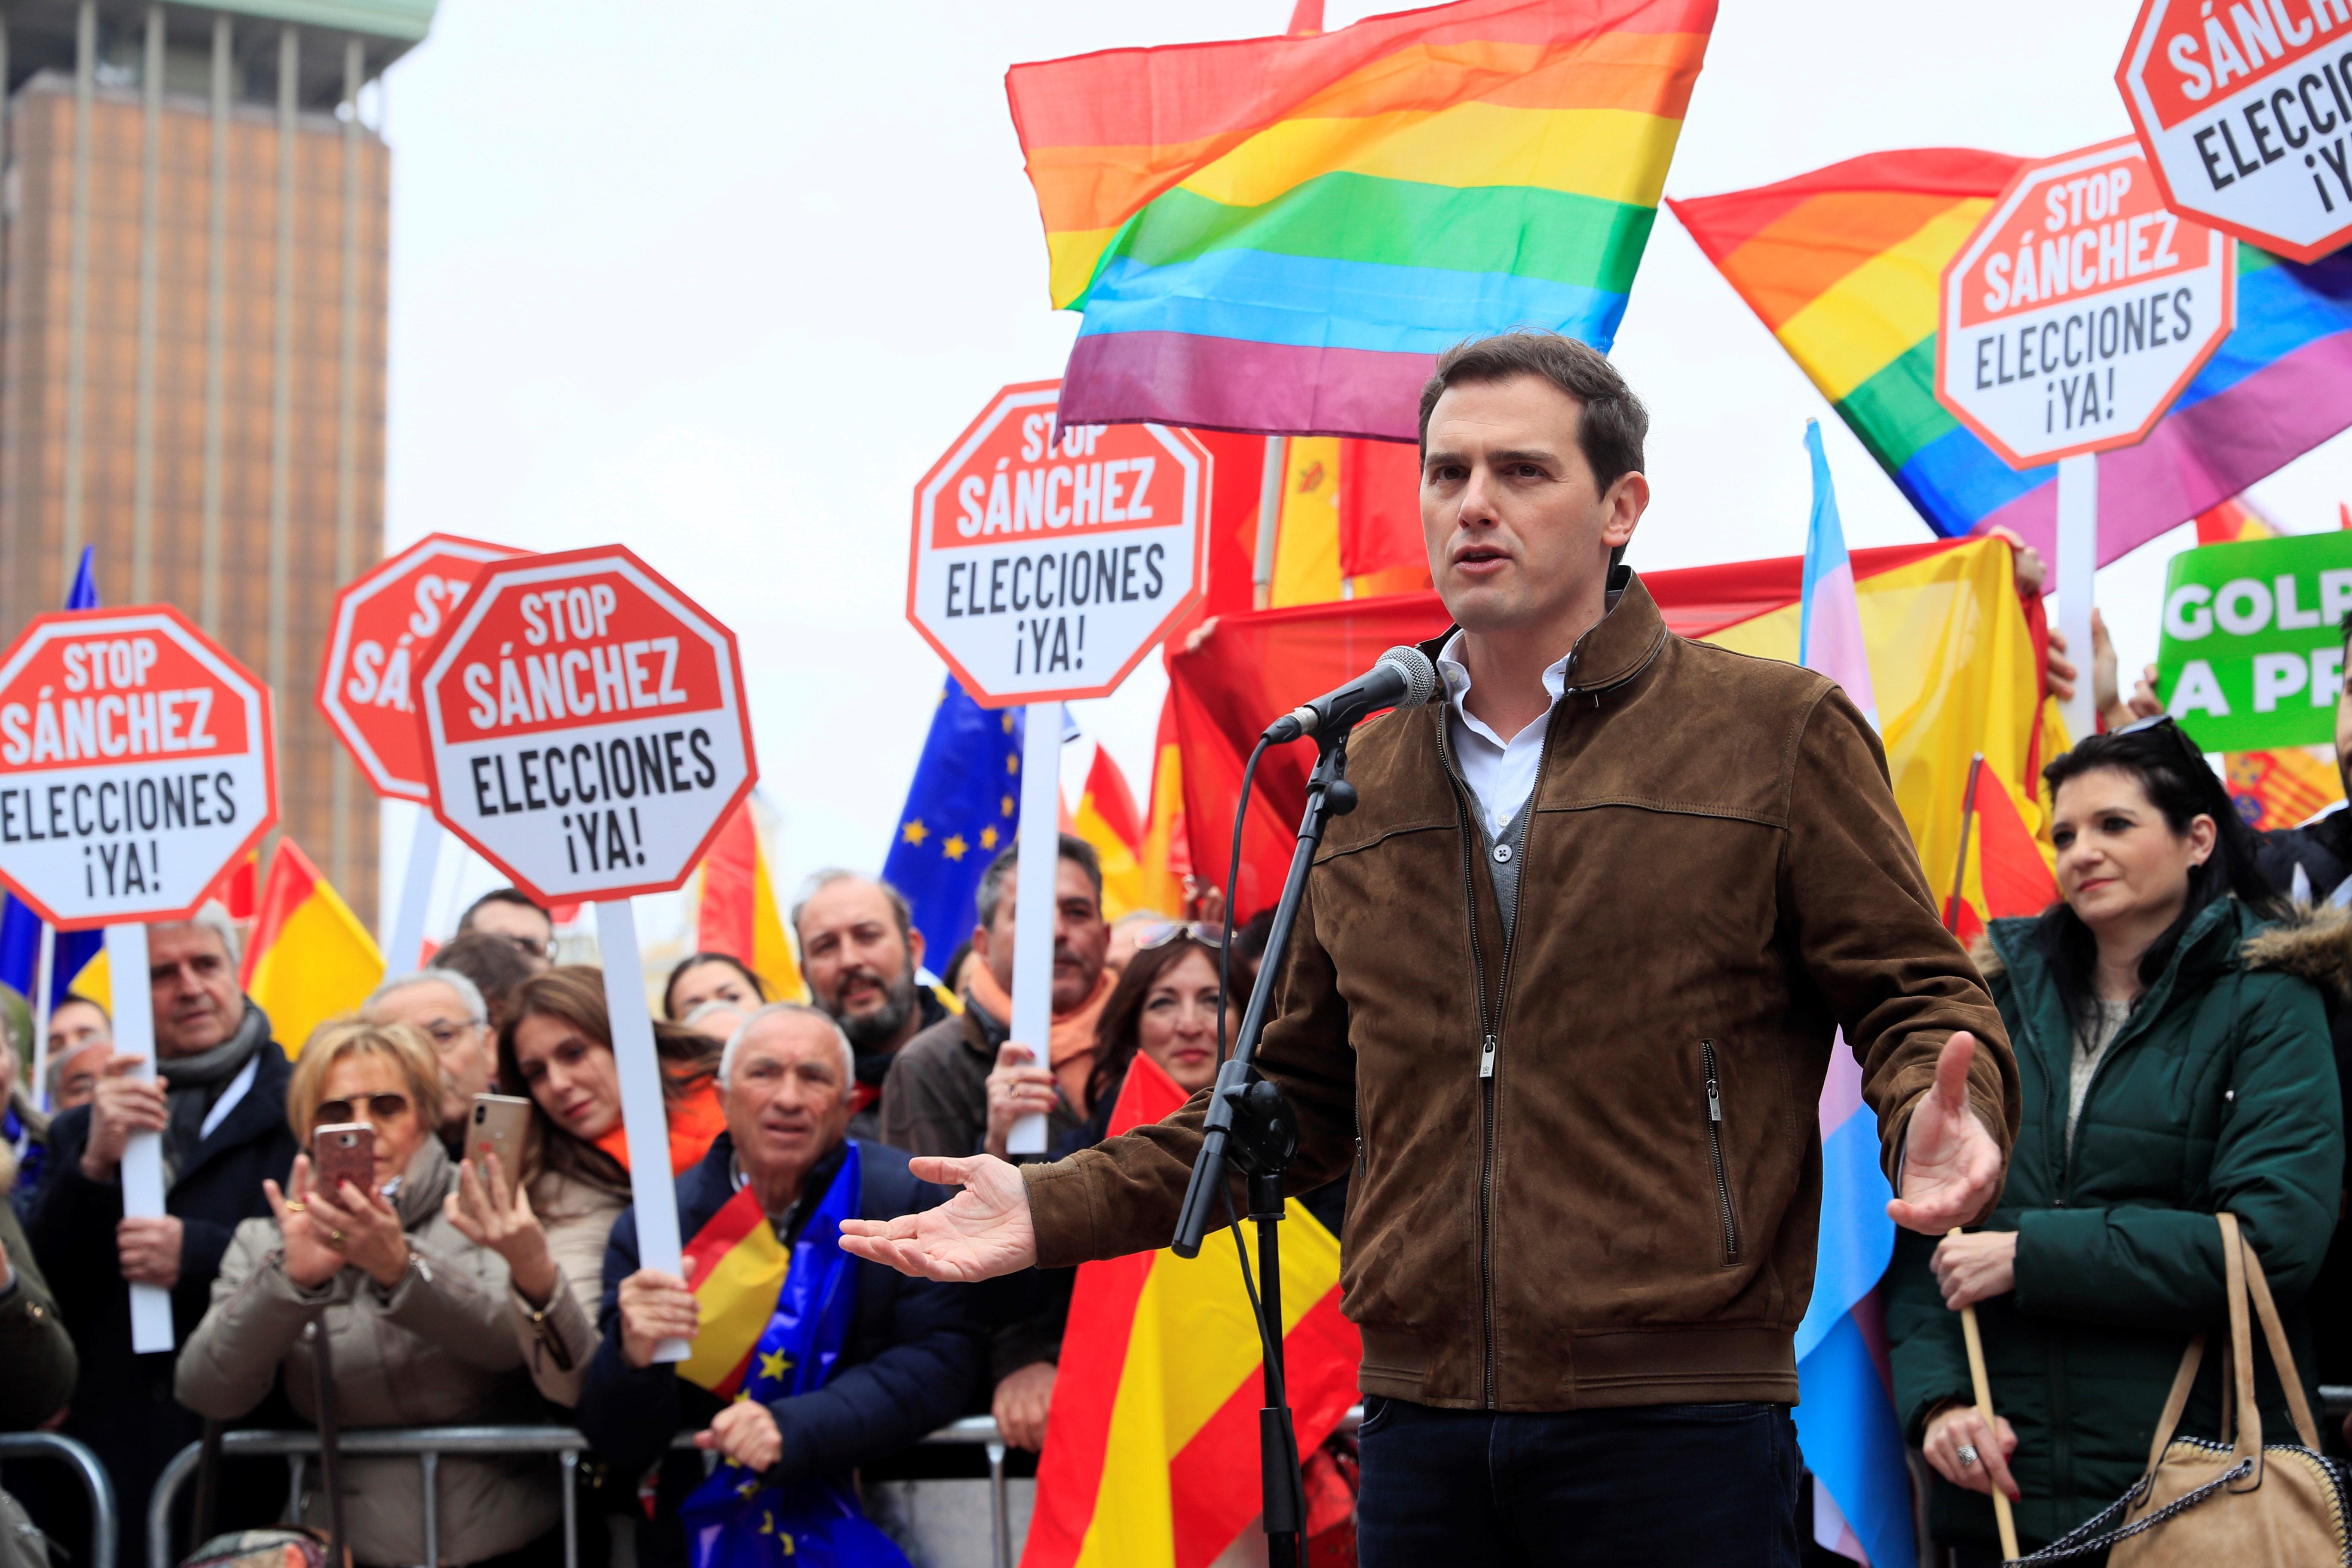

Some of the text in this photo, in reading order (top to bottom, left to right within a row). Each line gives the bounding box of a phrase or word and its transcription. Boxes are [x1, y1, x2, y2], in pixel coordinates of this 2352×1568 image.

[2167, 0, 2352, 100] SÁNCH
[2046, 168, 2132, 232] STOP
[1984, 208, 2179, 313] SÁNCHEZ
[1976, 287, 2192, 390] ELECCIONES
[2046, 368, 2115, 434] ¡YA!
[1021, 412, 1108, 463] STOP
[957, 456, 1155, 538] SÁNCHEZ
[946, 543, 1164, 618] ELECCIONES
[520, 584, 616, 646] STOP
[1015, 615, 1086, 675] ¡YA!
[63, 637, 157, 692] STOP
[463, 637, 687, 730] SÁNCHEZ
[2166, 659, 2231, 720] A
[0, 686, 217, 765] SÁNCHEZ
[470, 728, 717, 817] ELECCIONES
[0, 772, 236, 842] ELECCIONES
[562, 807, 646, 874] ¡YA!
[86, 840, 160, 898] ¡YA!
